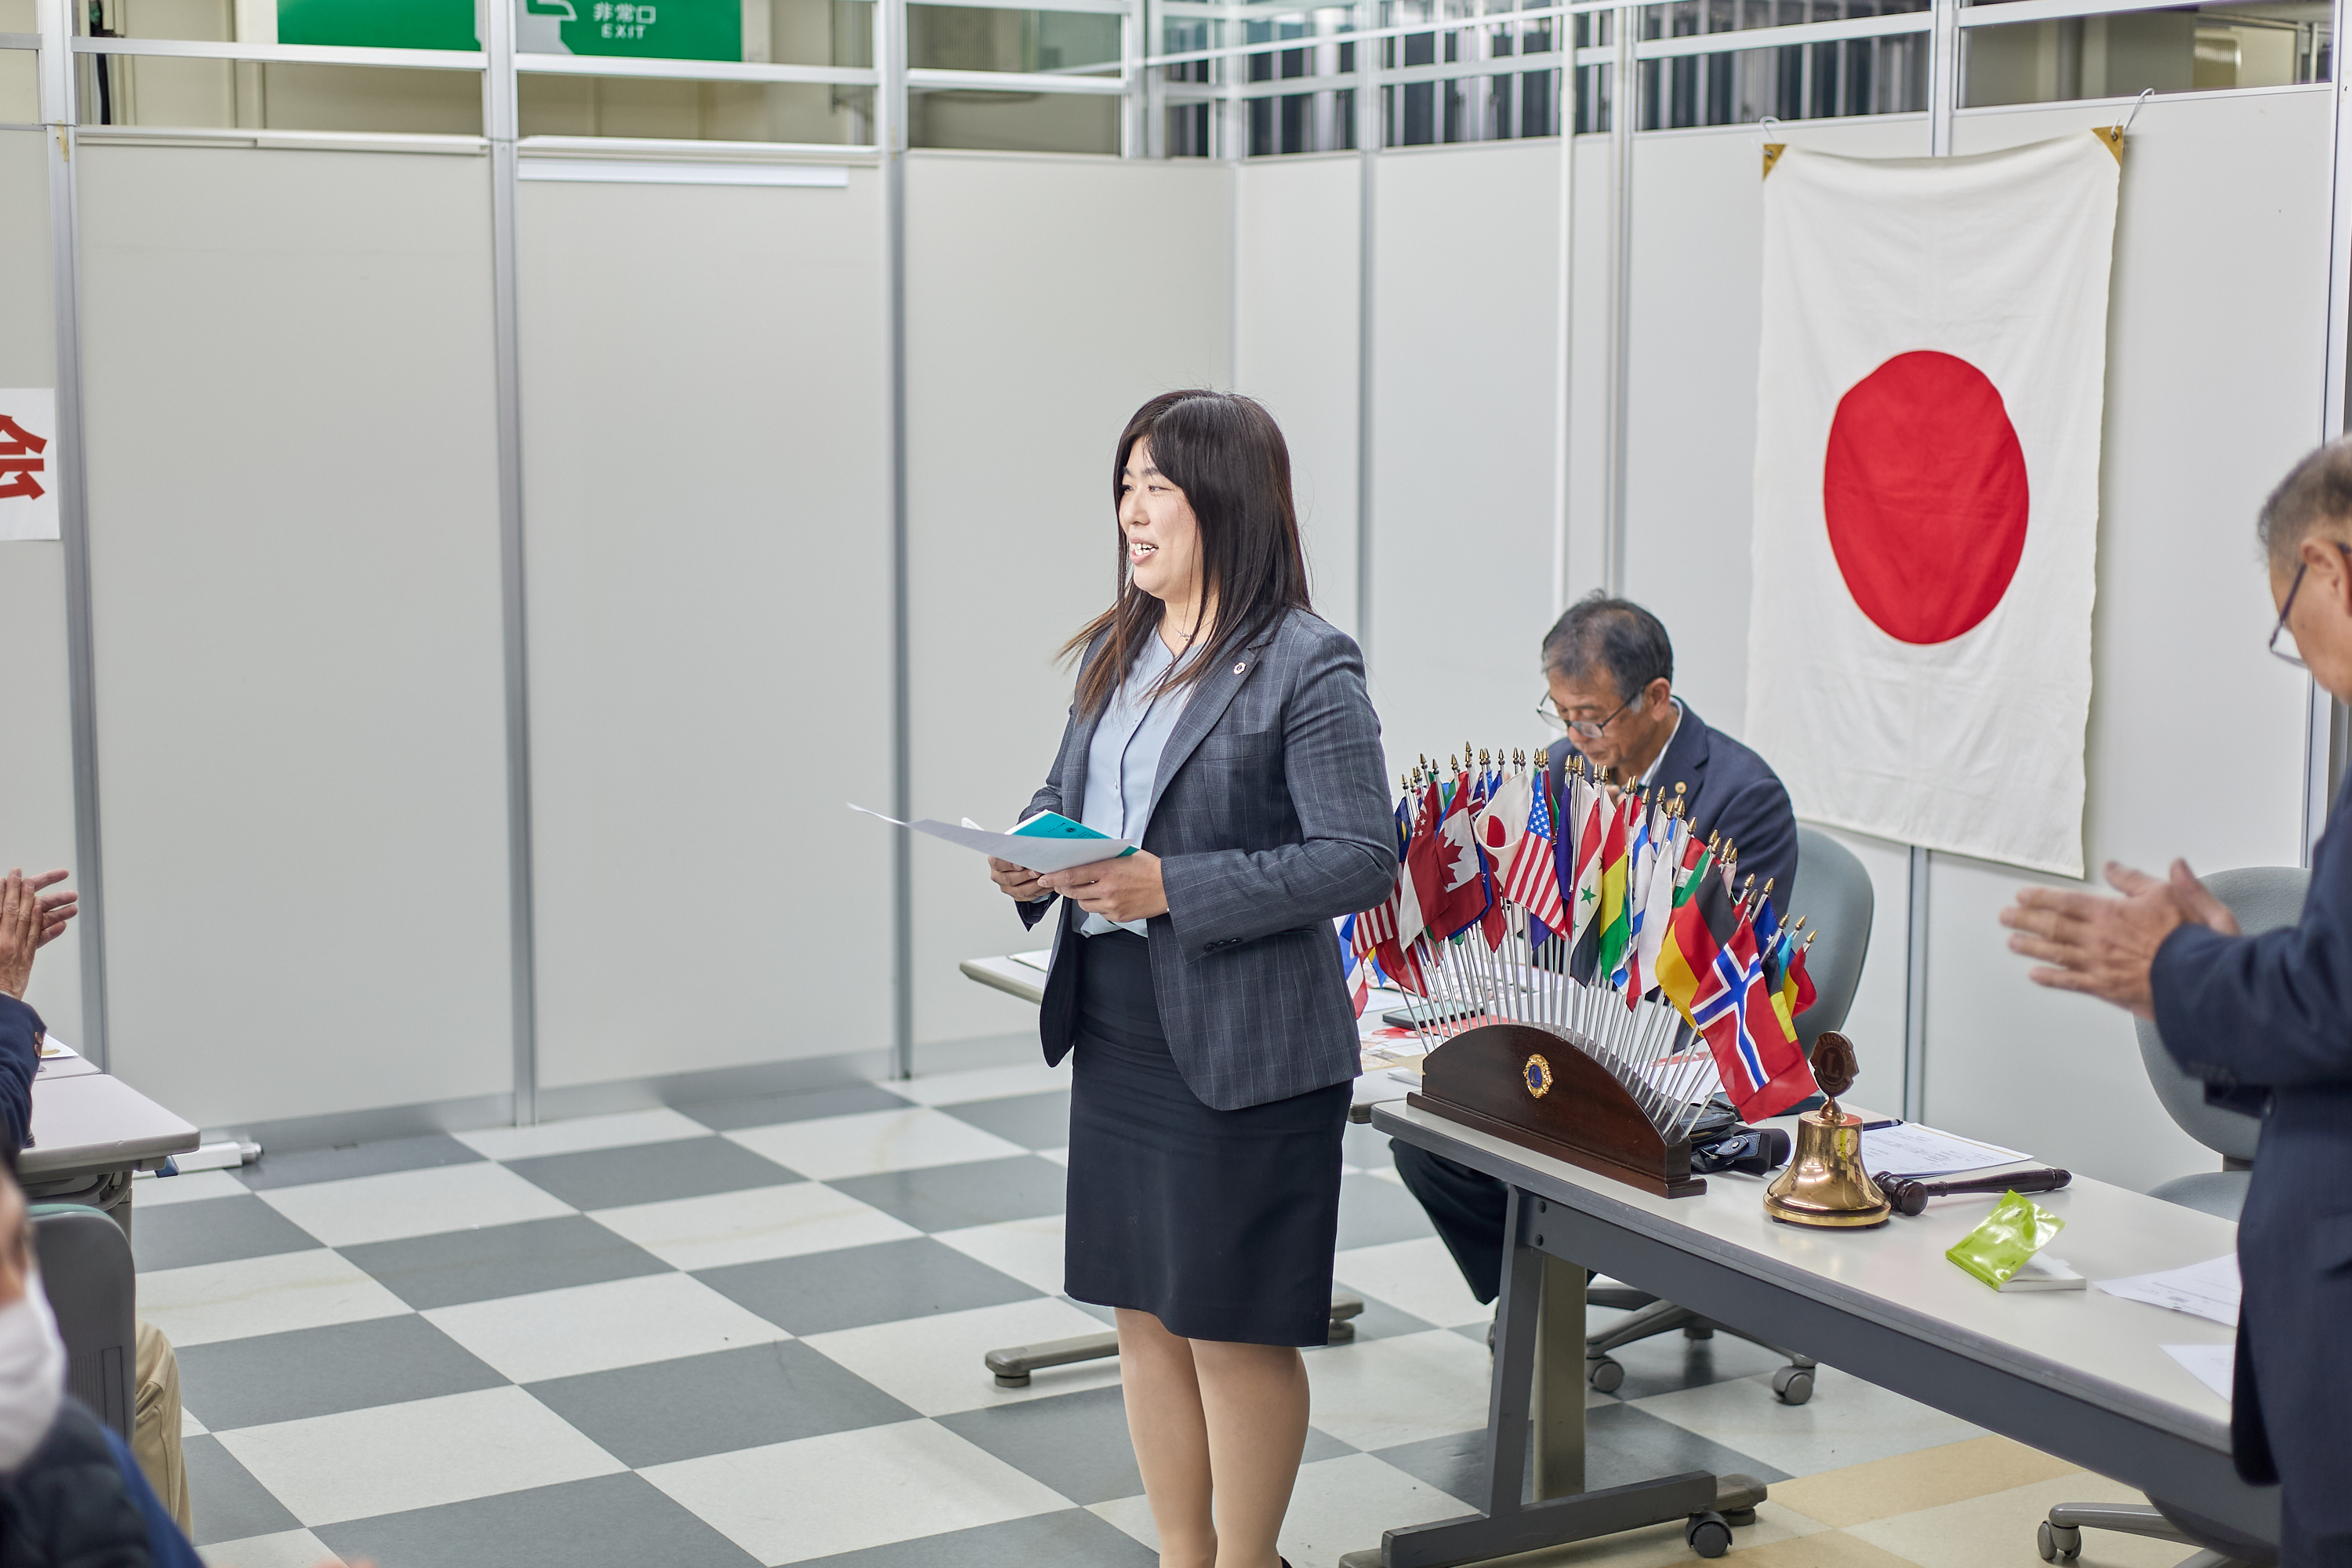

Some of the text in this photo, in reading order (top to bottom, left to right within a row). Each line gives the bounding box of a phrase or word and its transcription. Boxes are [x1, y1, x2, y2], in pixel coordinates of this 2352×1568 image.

[593, 2, 655, 24] 非常口
[601, 23, 646, 39] EXIT
